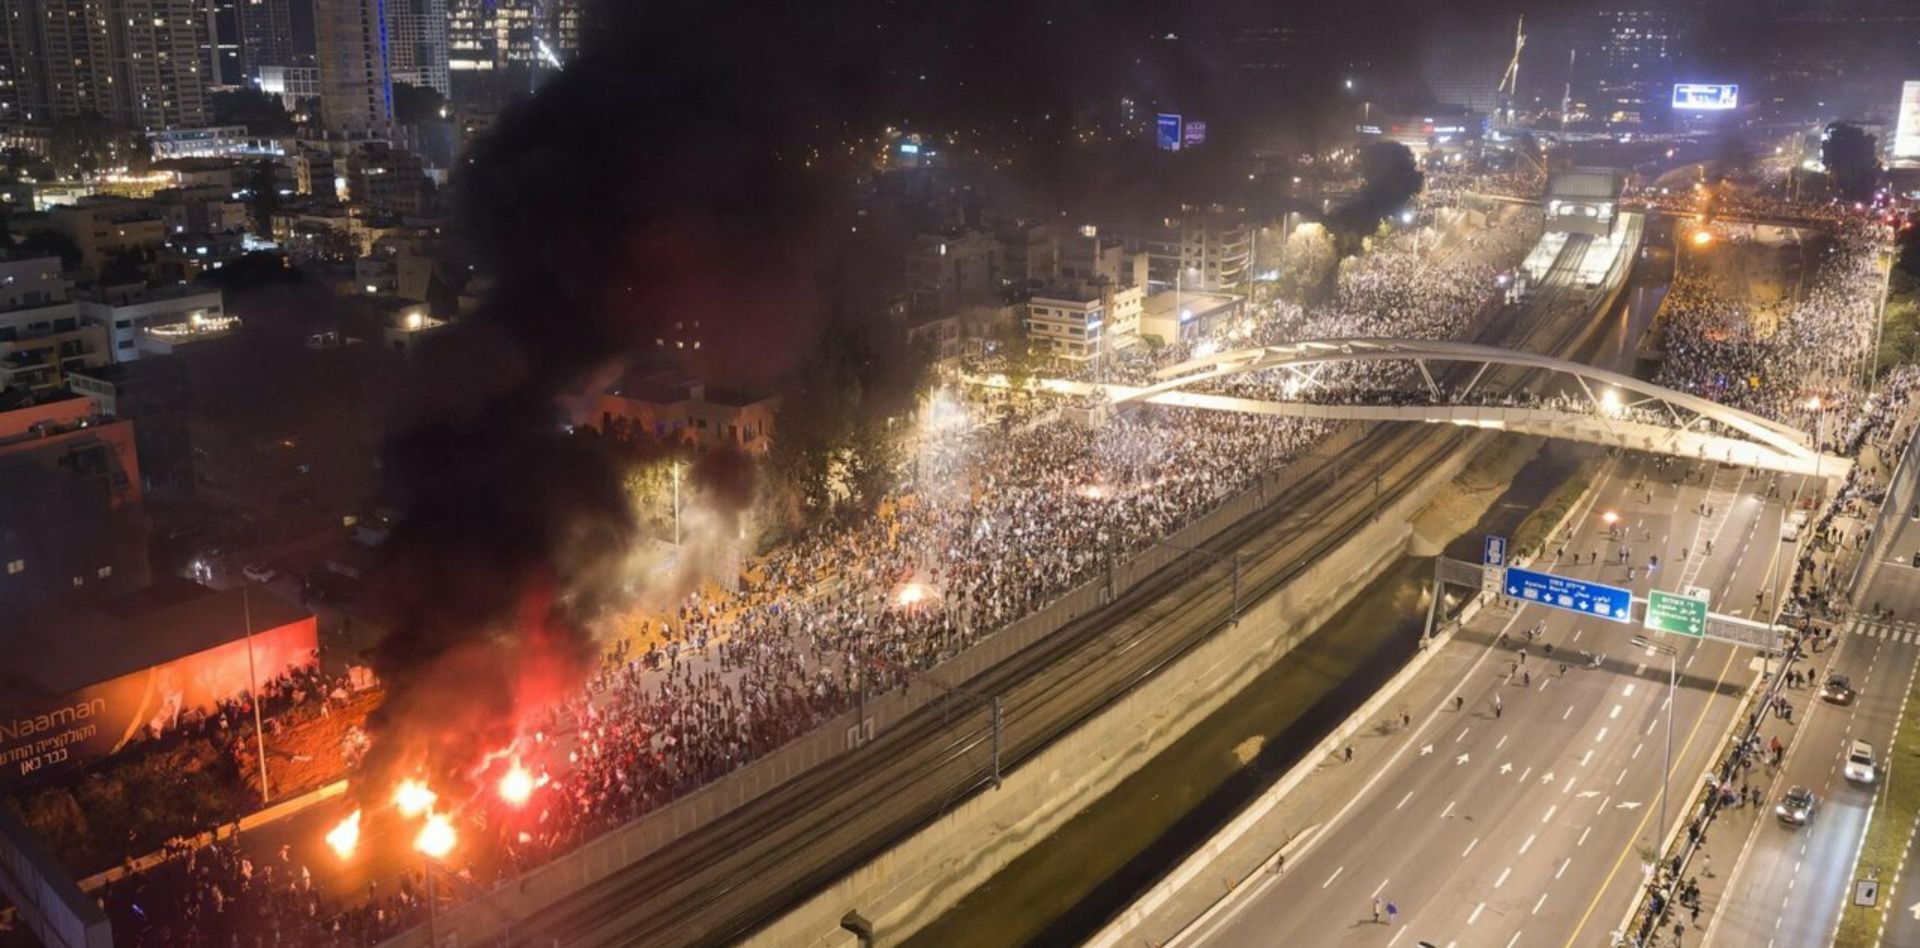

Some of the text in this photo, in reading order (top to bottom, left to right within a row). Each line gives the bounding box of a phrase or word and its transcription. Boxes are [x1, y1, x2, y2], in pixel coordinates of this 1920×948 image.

[0, 698, 105, 742] Naaman
[20, 747, 68, 776] כבר כאן
